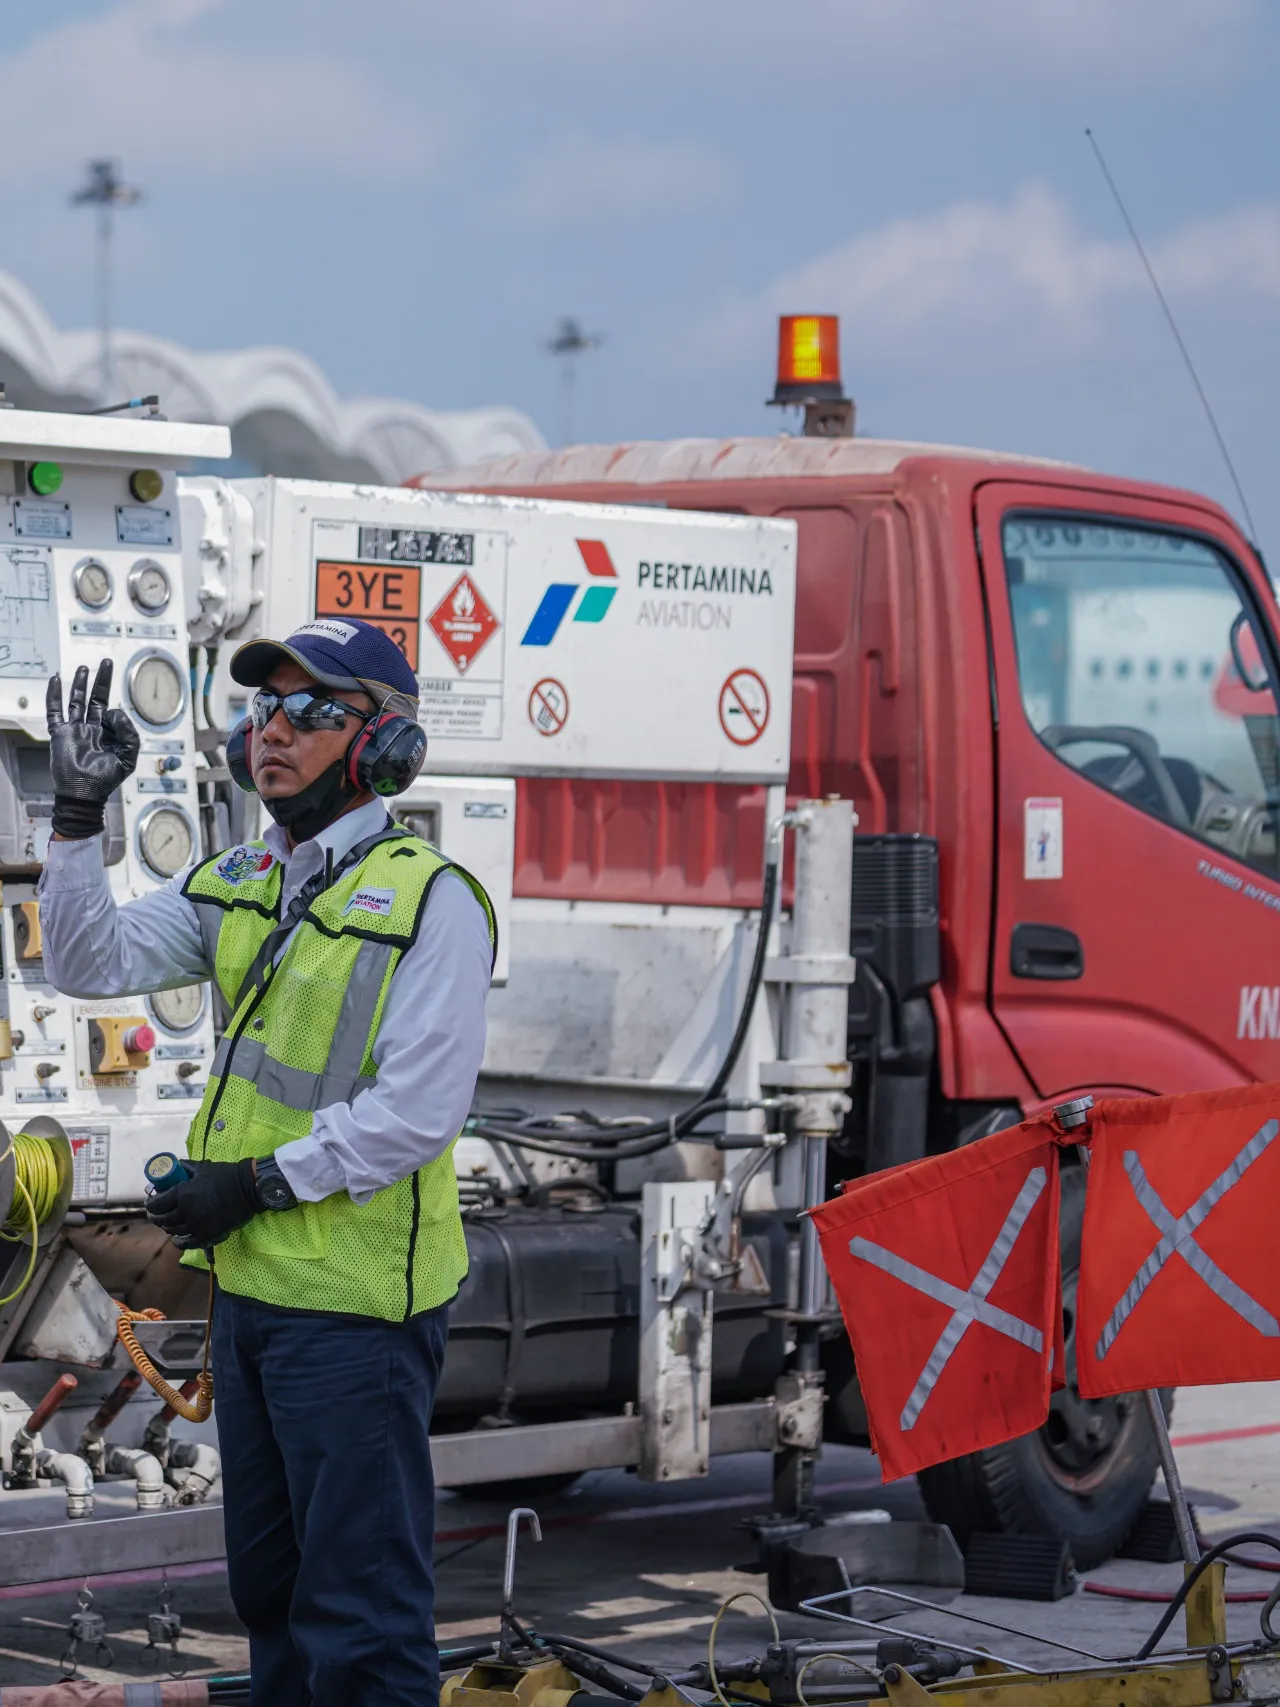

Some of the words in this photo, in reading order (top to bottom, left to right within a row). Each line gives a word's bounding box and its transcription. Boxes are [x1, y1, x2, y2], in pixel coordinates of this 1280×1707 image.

[638, 561, 773, 596] PERTAMINA
[335, 570, 403, 611] 3YE
[635, 600, 732, 632] AVIATION
[300, 624, 348, 638] PERTAMINA
[419, 680, 452, 692] UMBER
[354, 900, 381, 910] AVIATION
[356, 893, 390, 905] PERTAMINA
[80, 1005, 131, 1015] EMERGENCY
[1236, 985, 1280, 1041] KN
[82, 1077, 113, 1087] ENGINE
[116, 1077, 137, 1087] STOP
